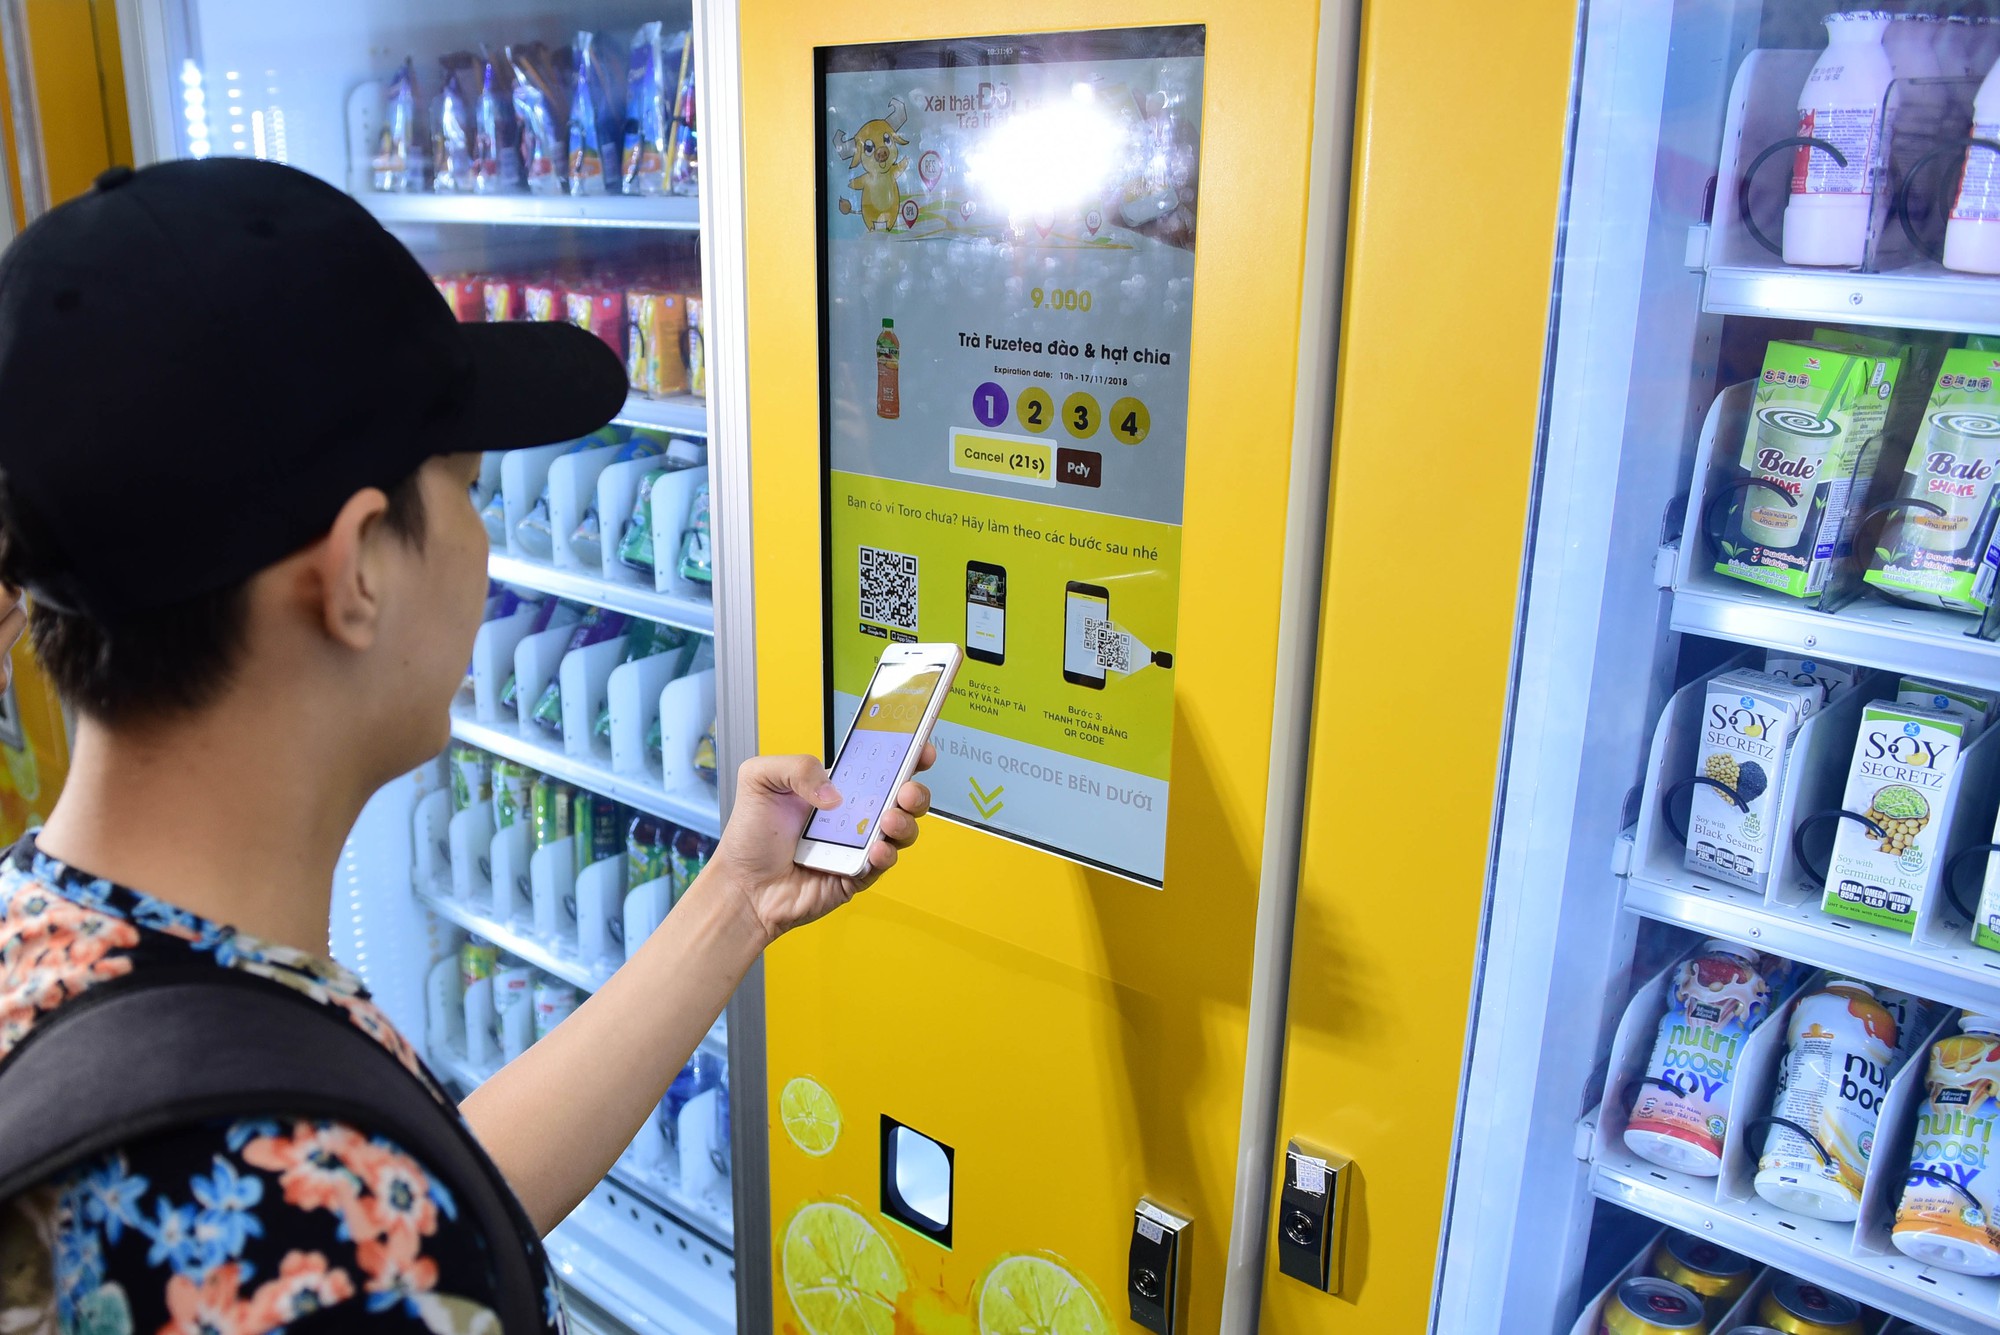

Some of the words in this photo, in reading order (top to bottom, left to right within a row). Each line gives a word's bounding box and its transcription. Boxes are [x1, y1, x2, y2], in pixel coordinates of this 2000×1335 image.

[924, 96, 945, 112] Xài
[1030, 288, 1092, 312] 9.000
[959, 332, 980, 348] Trà
[985, 334, 1042, 354] Fuzetea
[1048, 340, 1079, 357] đào
[1084, 343, 1096, 358] &
[1102, 344, 1129, 365] hạt
[1133, 348, 1171, 365] chia
[994, 366, 1031, 377] Expiration
[1033, 368, 1053, 379] date:
[1060, 372, 1074, 381] 10h
[1080, 374, 1128, 386] 17/11/2018
[985, 396, 994, 419] 1
[1028, 400, 1042, 424] 2
[1074, 406, 1088, 430] 3
[1120, 412, 1138, 436] 4
[964, 448, 1004, 464] Cancel
[1009, 454, 1044, 474] (21s)
[1067, 462, 1091, 478] Pay
[1930, 480, 1975, 496] SHAKE
[848, 494, 866, 509] Bạn
[870, 500, 882, 512] có
[886, 502, 894, 514] ví
[898, 504, 922, 519] Toro
[925, 509, 958, 525] chưa?
[962, 515, 984, 533] Hãy
[988, 519, 1010, 535] làm
[1013, 524, 1041, 540] theo
[1045, 530, 1065, 544] các
[1070, 532, 1102, 551] bước
[1106, 543, 1128, 556] sau
[1133, 545, 1158, 561] nhé
[968, 688, 979, 700] KÝ
[969, 680, 992, 692] Bước
[1043, 711, 1073, 726] THANH
[1076, 716, 1100, 732] TOÁN
[1068, 706, 1093, 718] Bước
[1096, 712, 1103, 721] 3:
[1710, 704, 1778, 742] SOY
[1064, 728, 1078, 738] QR
[1080, 732, 1105, 746] CODE
[1707, 732, 1774, 760] SECRETZ
[1865, 732, 1950, 770] SOY
[950, 736, 993, 765] BẰNG
[998, 754, 1064, 786] QRCODE
[1068, 774, 1100, 797] BÊN
[1106, 785, 1153, 812] DƯỚI
[1861, 762, 1944, 788] SECRETZ
[1696, 814, 1710, 825] Soy
[1712, 820, 1726, 830] with
[1744, 822, 1760, 832] GMO
[1745, 816, 1760, 825] NON
[1695, 824, 1723, 841] Black
[1726, 834, 1763, 854] Sesame
[1837, 854, 1852, 865] Soy
[1856, 858, 1874, 868] with
[1901, 854, 1922, 864] GMO
[1903, 848, 1923, 858] NON
[1835, 864, 1896, 886] Germinated
[1899, 878, 1923, 892] Rice
[1840, 882, 1862, 894] GABA
[1864, 886, 1887, 900] OMEGA
[1864, 896, 1884, 907] 3.6.9
[1888, 894, 1912, 906] VITAMIN
[1890, 903, 1906, 912] B12
[1874, 912, 1903, 922] Germinated
[1663, 1046, 1732, 1084] boost
[1658, 1068, 1724, 1102] SOY
[1906, 1162, 1981, 1188] SOY
